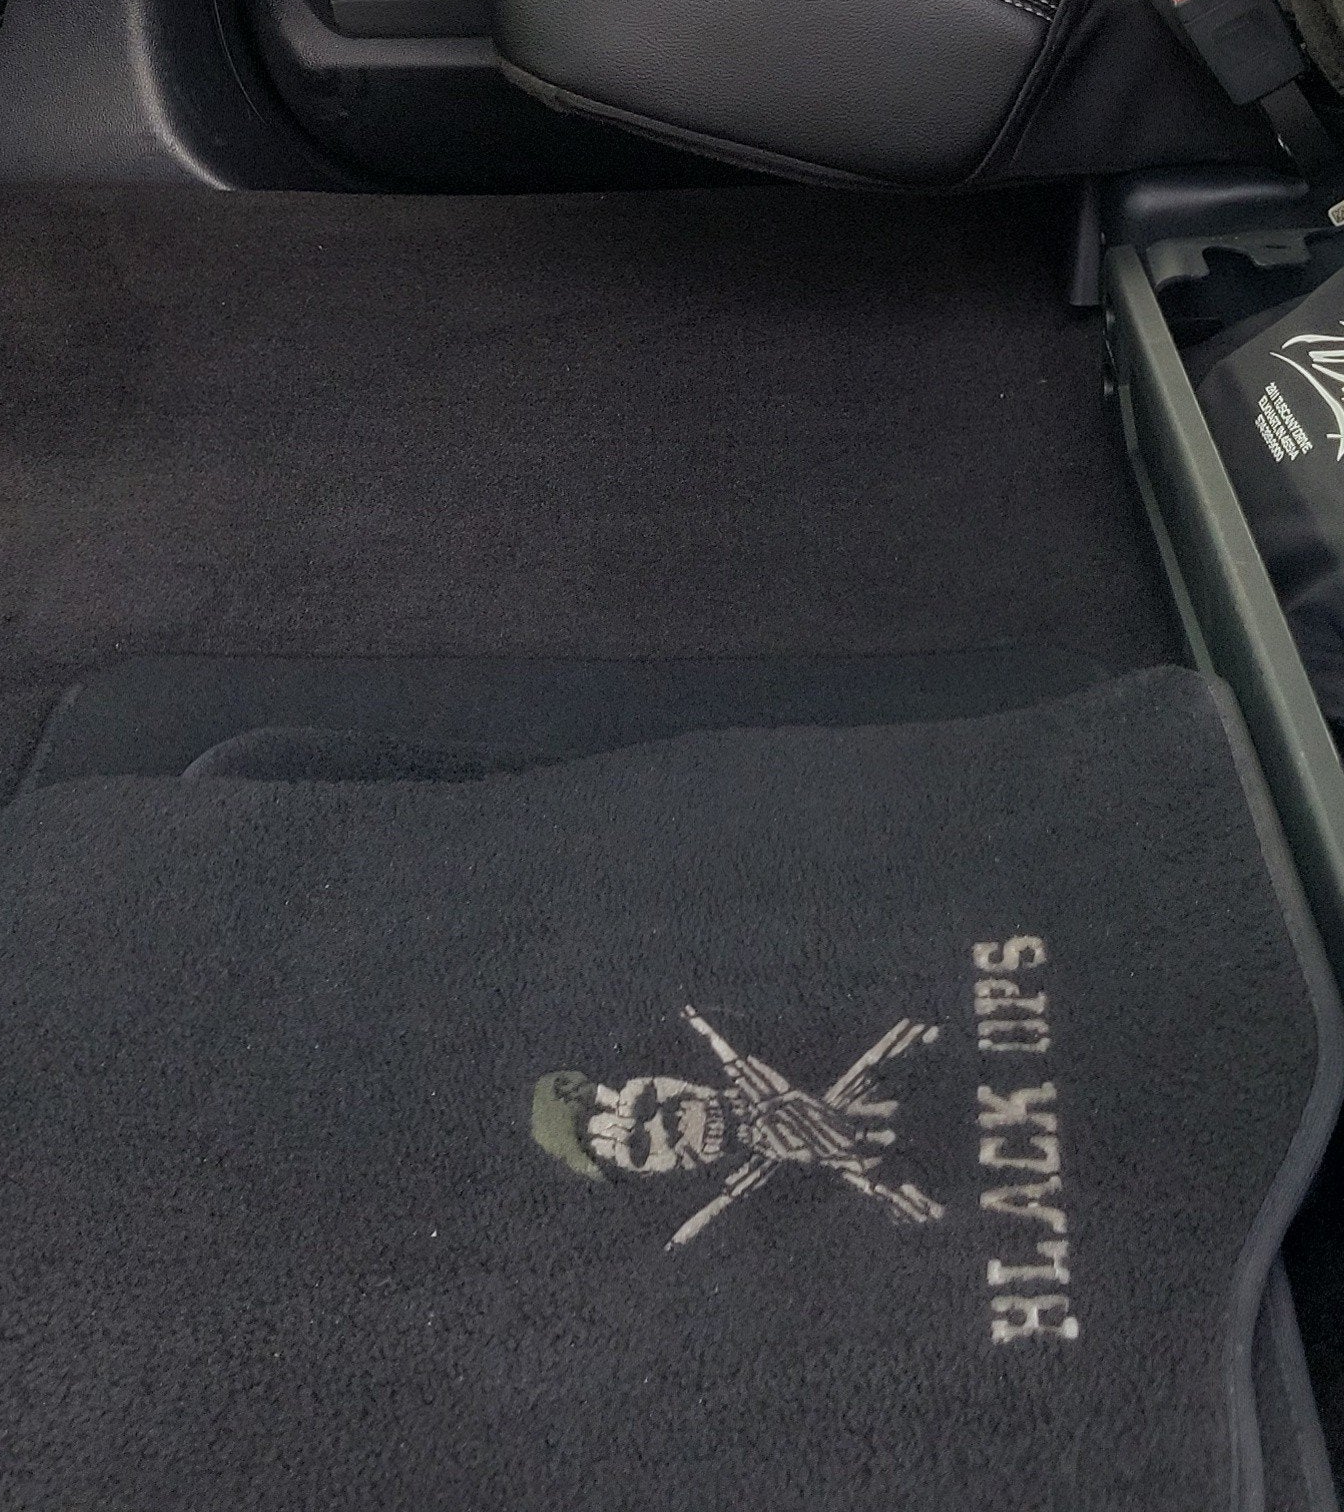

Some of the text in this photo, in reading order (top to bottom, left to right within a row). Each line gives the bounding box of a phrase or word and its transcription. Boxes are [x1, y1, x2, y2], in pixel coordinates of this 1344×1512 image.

[1274, 395, 1301, 431] TUSCANY
[1291, 428, 1313, 455] DRIVE
[972, 934, 1080, 1344] BLACK OPS
